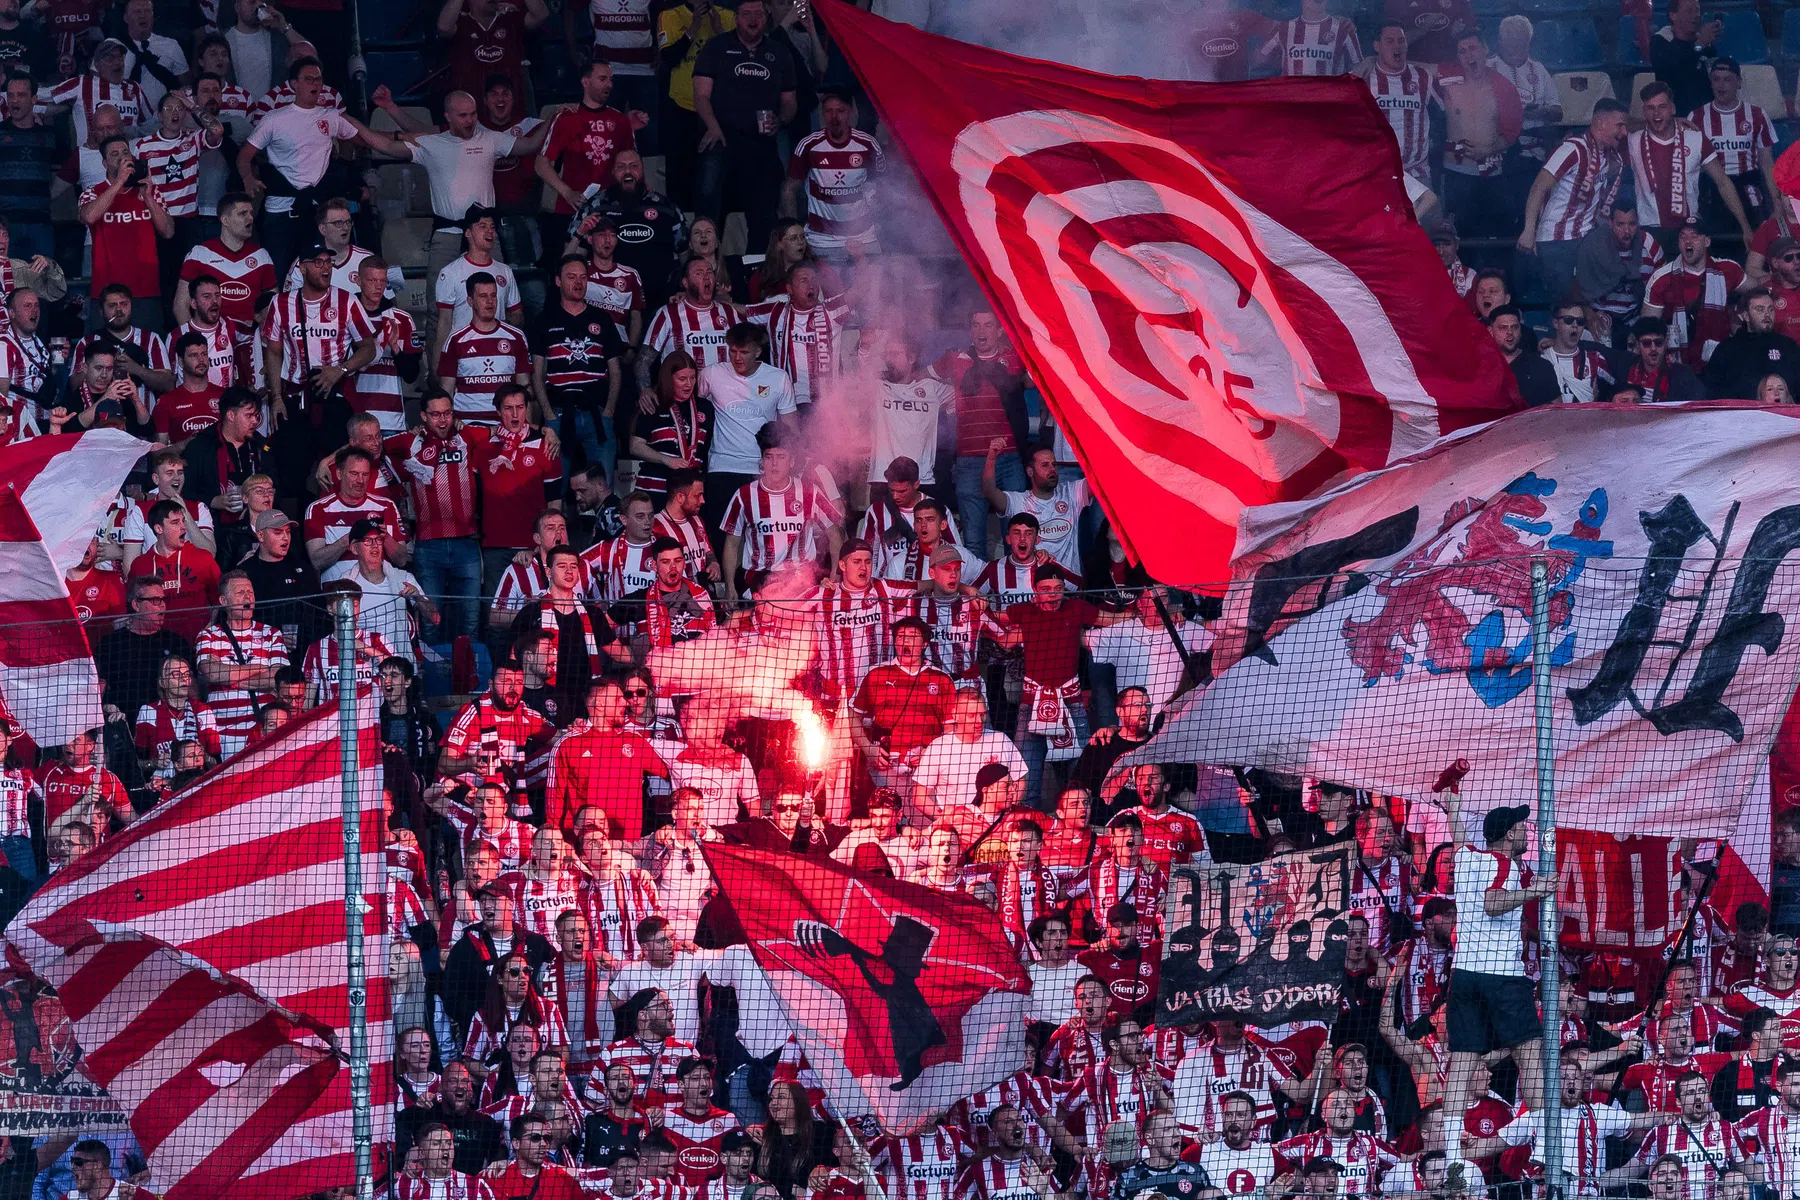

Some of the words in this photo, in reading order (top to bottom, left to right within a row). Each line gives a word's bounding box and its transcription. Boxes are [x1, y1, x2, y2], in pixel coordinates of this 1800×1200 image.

[1205, 43, 1235, 54] Henkel
[737, 68, 767, 78] Henkel
[104, 210, 151, 224] OTELO
[220, 286, 249, 297] Henkel
[465, 376, 512, 386] TARGOBANK
[1039, 524, 1070, 536] Henkel
[681, 1152, 716, 1165] Henkel
